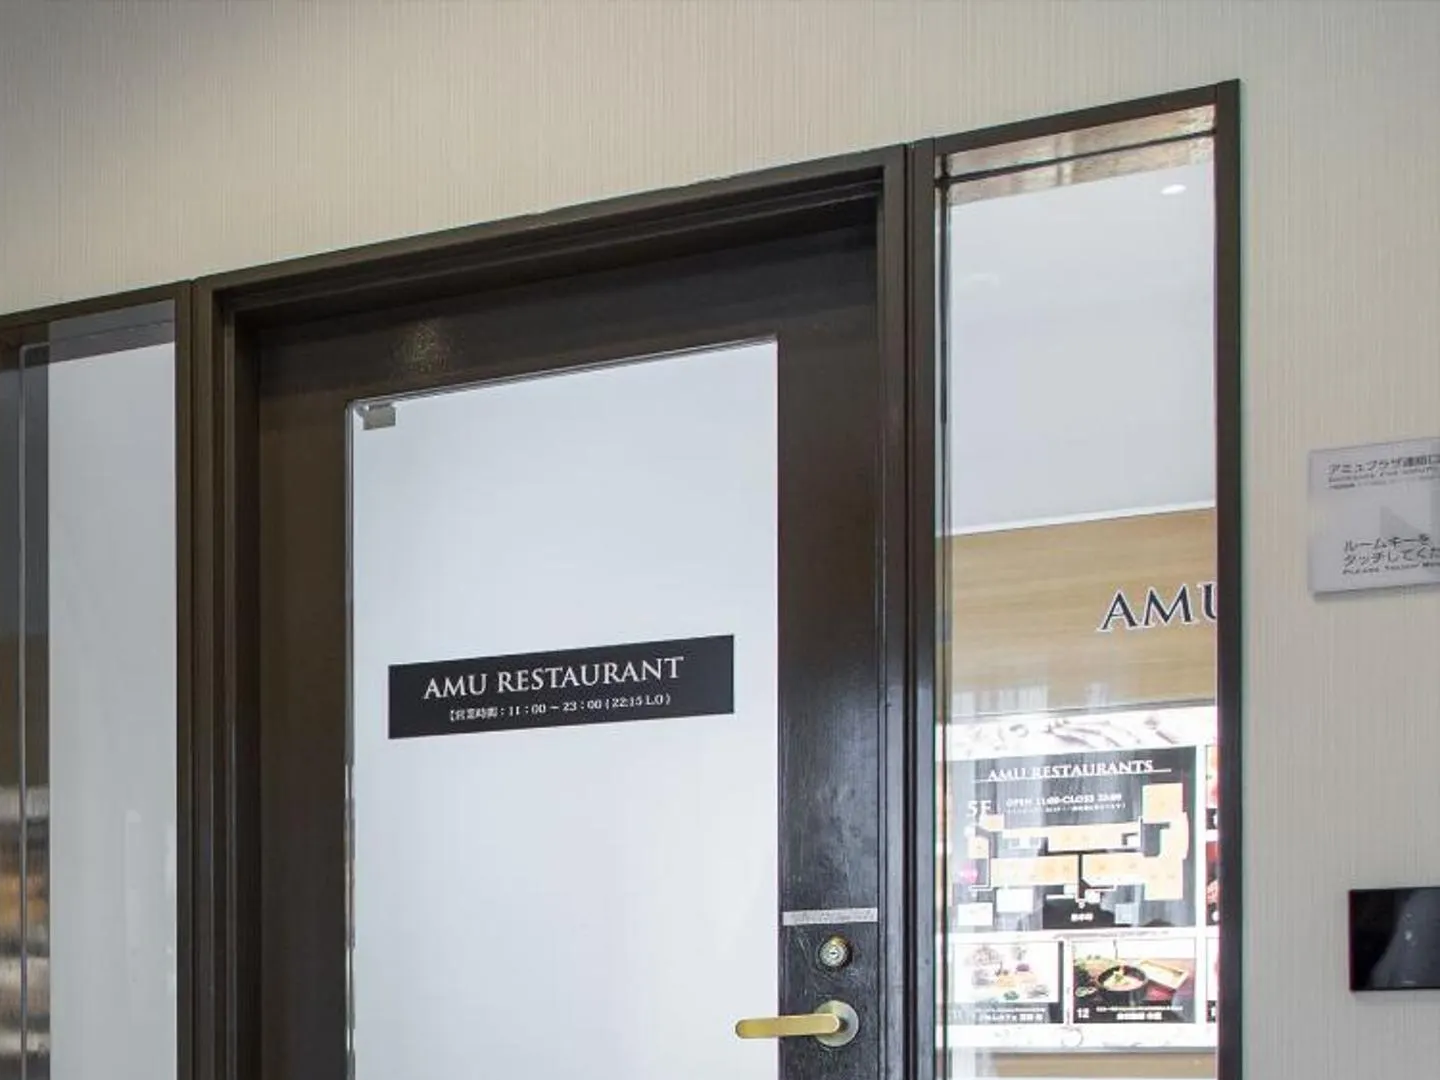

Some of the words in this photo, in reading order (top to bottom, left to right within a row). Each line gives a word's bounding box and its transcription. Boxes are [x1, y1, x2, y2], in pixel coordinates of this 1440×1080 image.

[1096, 580, 1218, 633] AMU
[424, 673, 488, 699] AMU
[497, 656, 684, 693] RESTAURANT
[1031, 759, 1152, 779] RESTAURANTS
